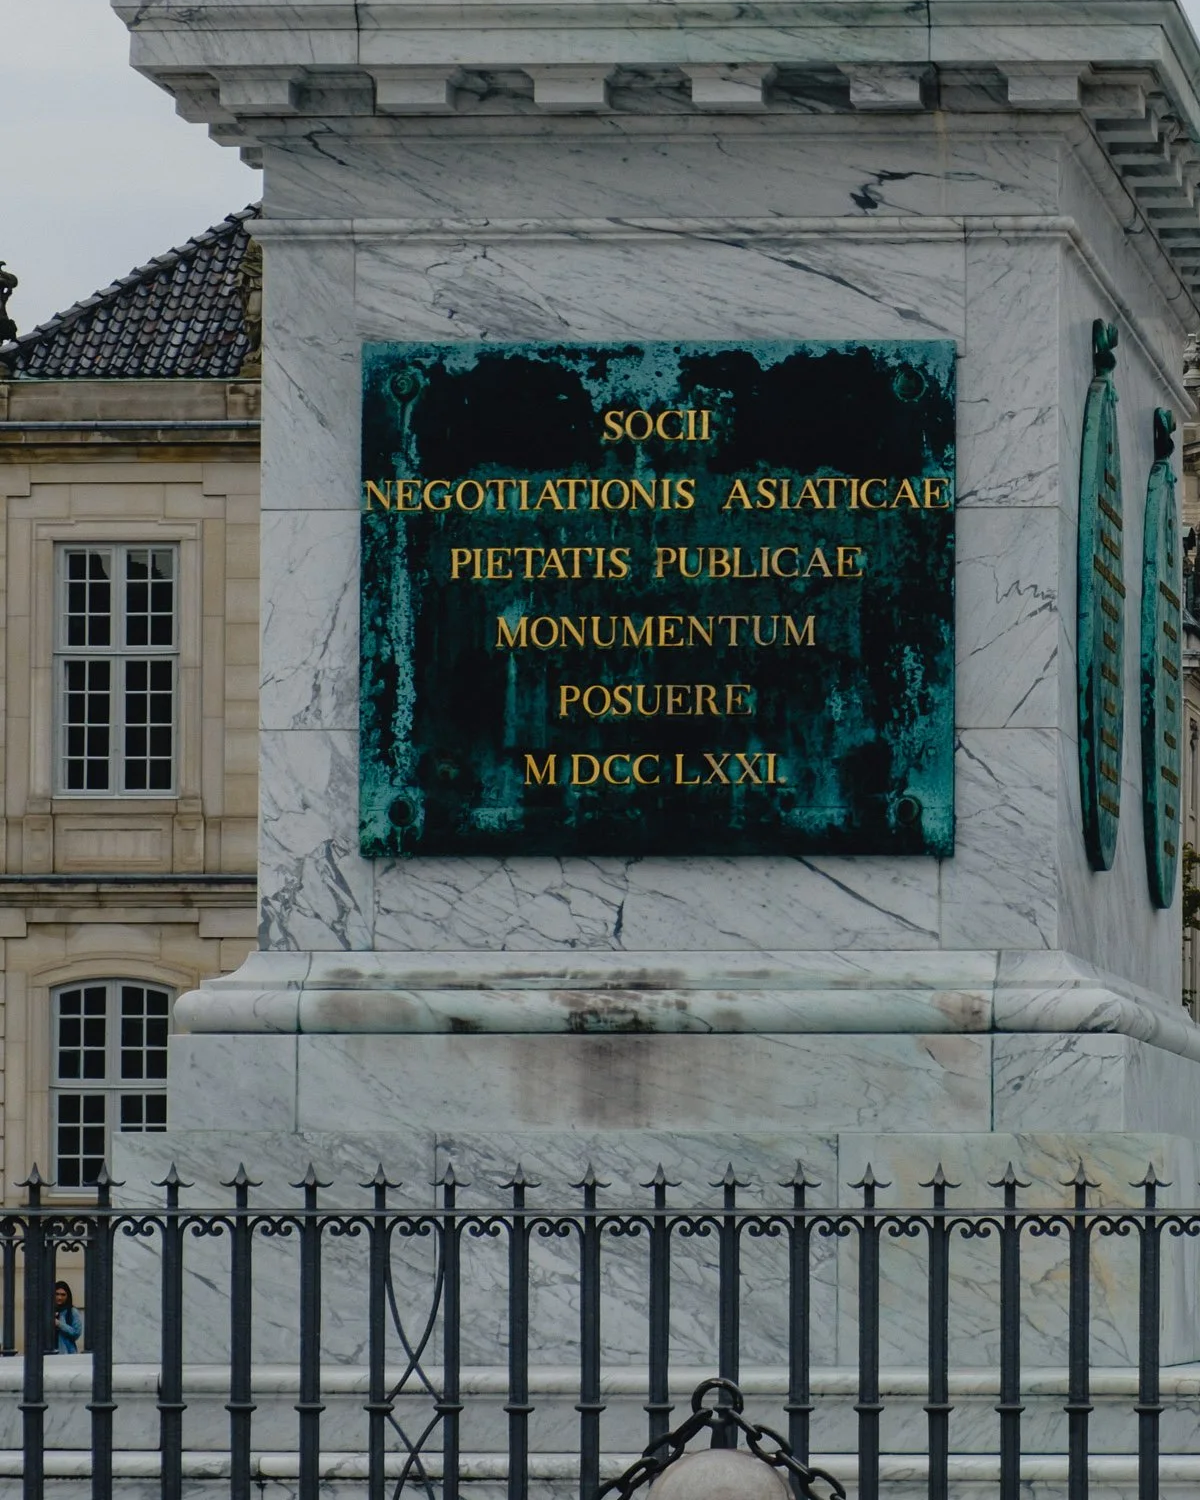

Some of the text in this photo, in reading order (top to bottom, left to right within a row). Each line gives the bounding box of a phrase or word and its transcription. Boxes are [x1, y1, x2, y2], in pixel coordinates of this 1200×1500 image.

[603, 410, 711, 440] SOCII
[365, 478, 950, 511] NEGOTIATIONIS ASIATICAE
[450, 547, 863, 579] PIETATIS PUBLICAE
[495, 616, 816, 648] MONUMENTUM
[559, 684, 752, 716] POSUERE
[524, 754, 556, 784] M
[571, 754, 660, 785] DCC
